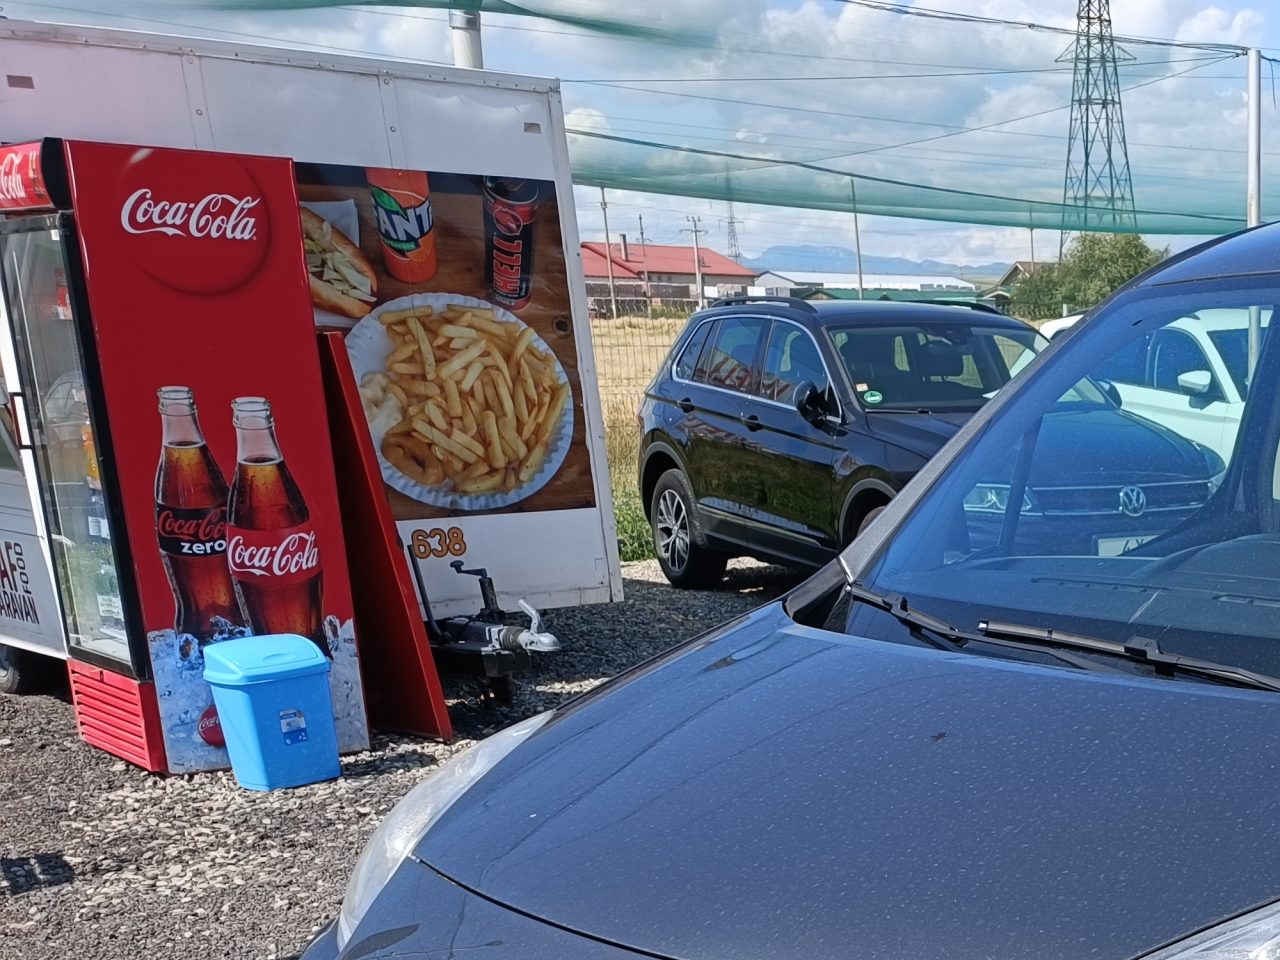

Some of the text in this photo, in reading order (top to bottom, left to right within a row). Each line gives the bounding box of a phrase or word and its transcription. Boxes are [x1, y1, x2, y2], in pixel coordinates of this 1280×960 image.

[121, 188, 261, 240] Coca-Cola
[372, 197, 433, 241] ANT
[493, 236, 523, 298] HELL
[158, 508, 227, 542] Coca-Co
[181, 539, 227, 555] zero
[411, 527, 467, 559] 638
[14, 542, 32, 595] FOOD
[228, 531, 319, 576] Coca-Cola
